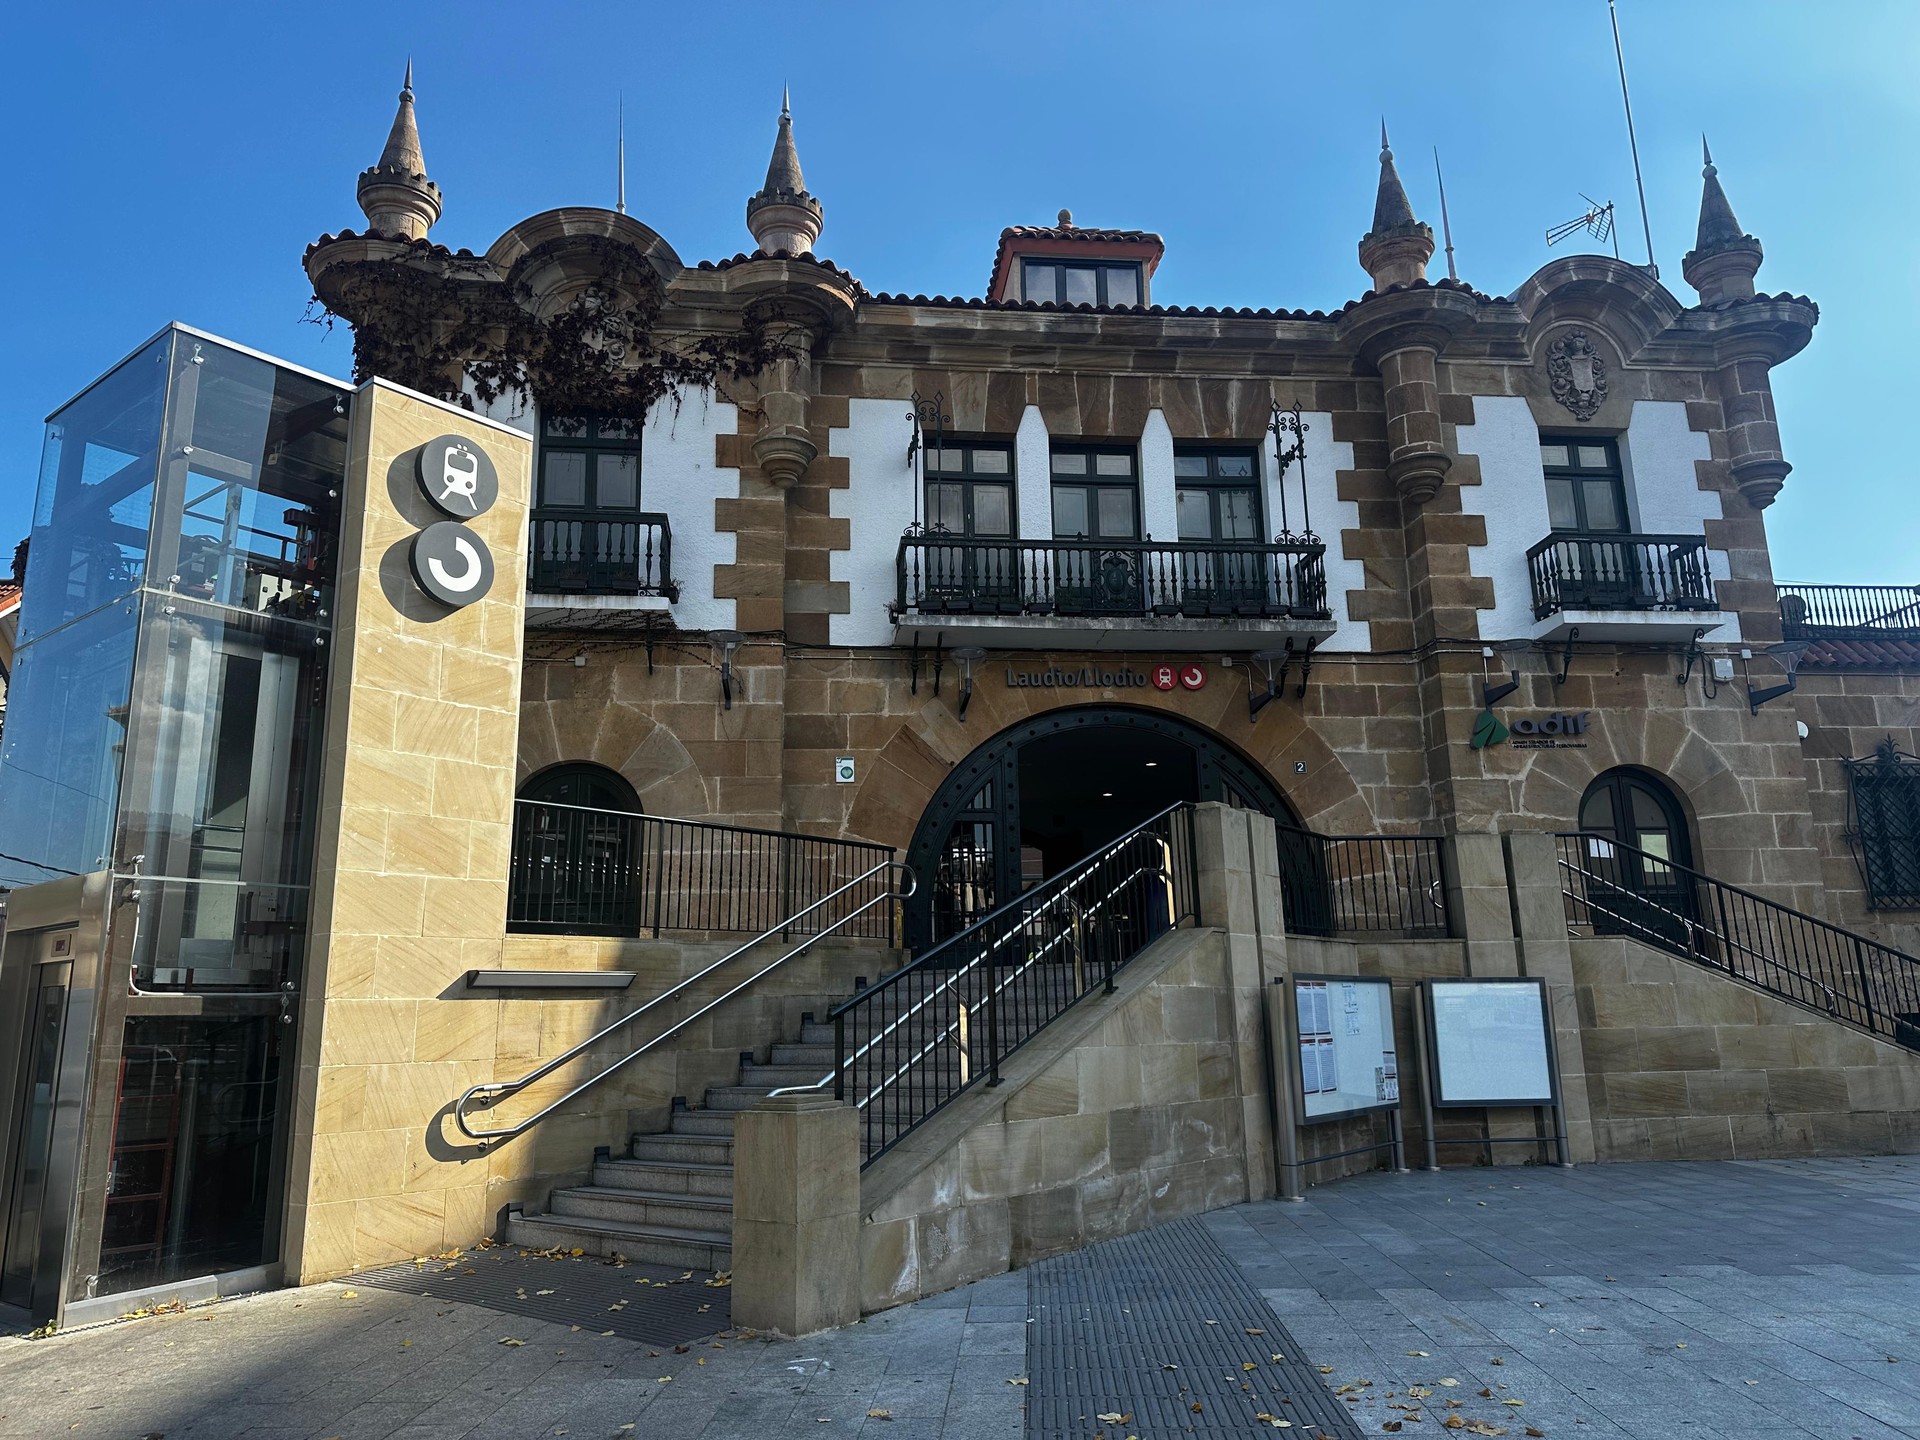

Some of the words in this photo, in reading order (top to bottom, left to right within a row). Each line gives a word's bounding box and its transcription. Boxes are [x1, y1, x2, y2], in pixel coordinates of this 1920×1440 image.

[1007, 667, 1147, 687] Laudio/Llodio
[1512, 711, 1590, 735] adif
[1297, 762, 1304, 772] 2
